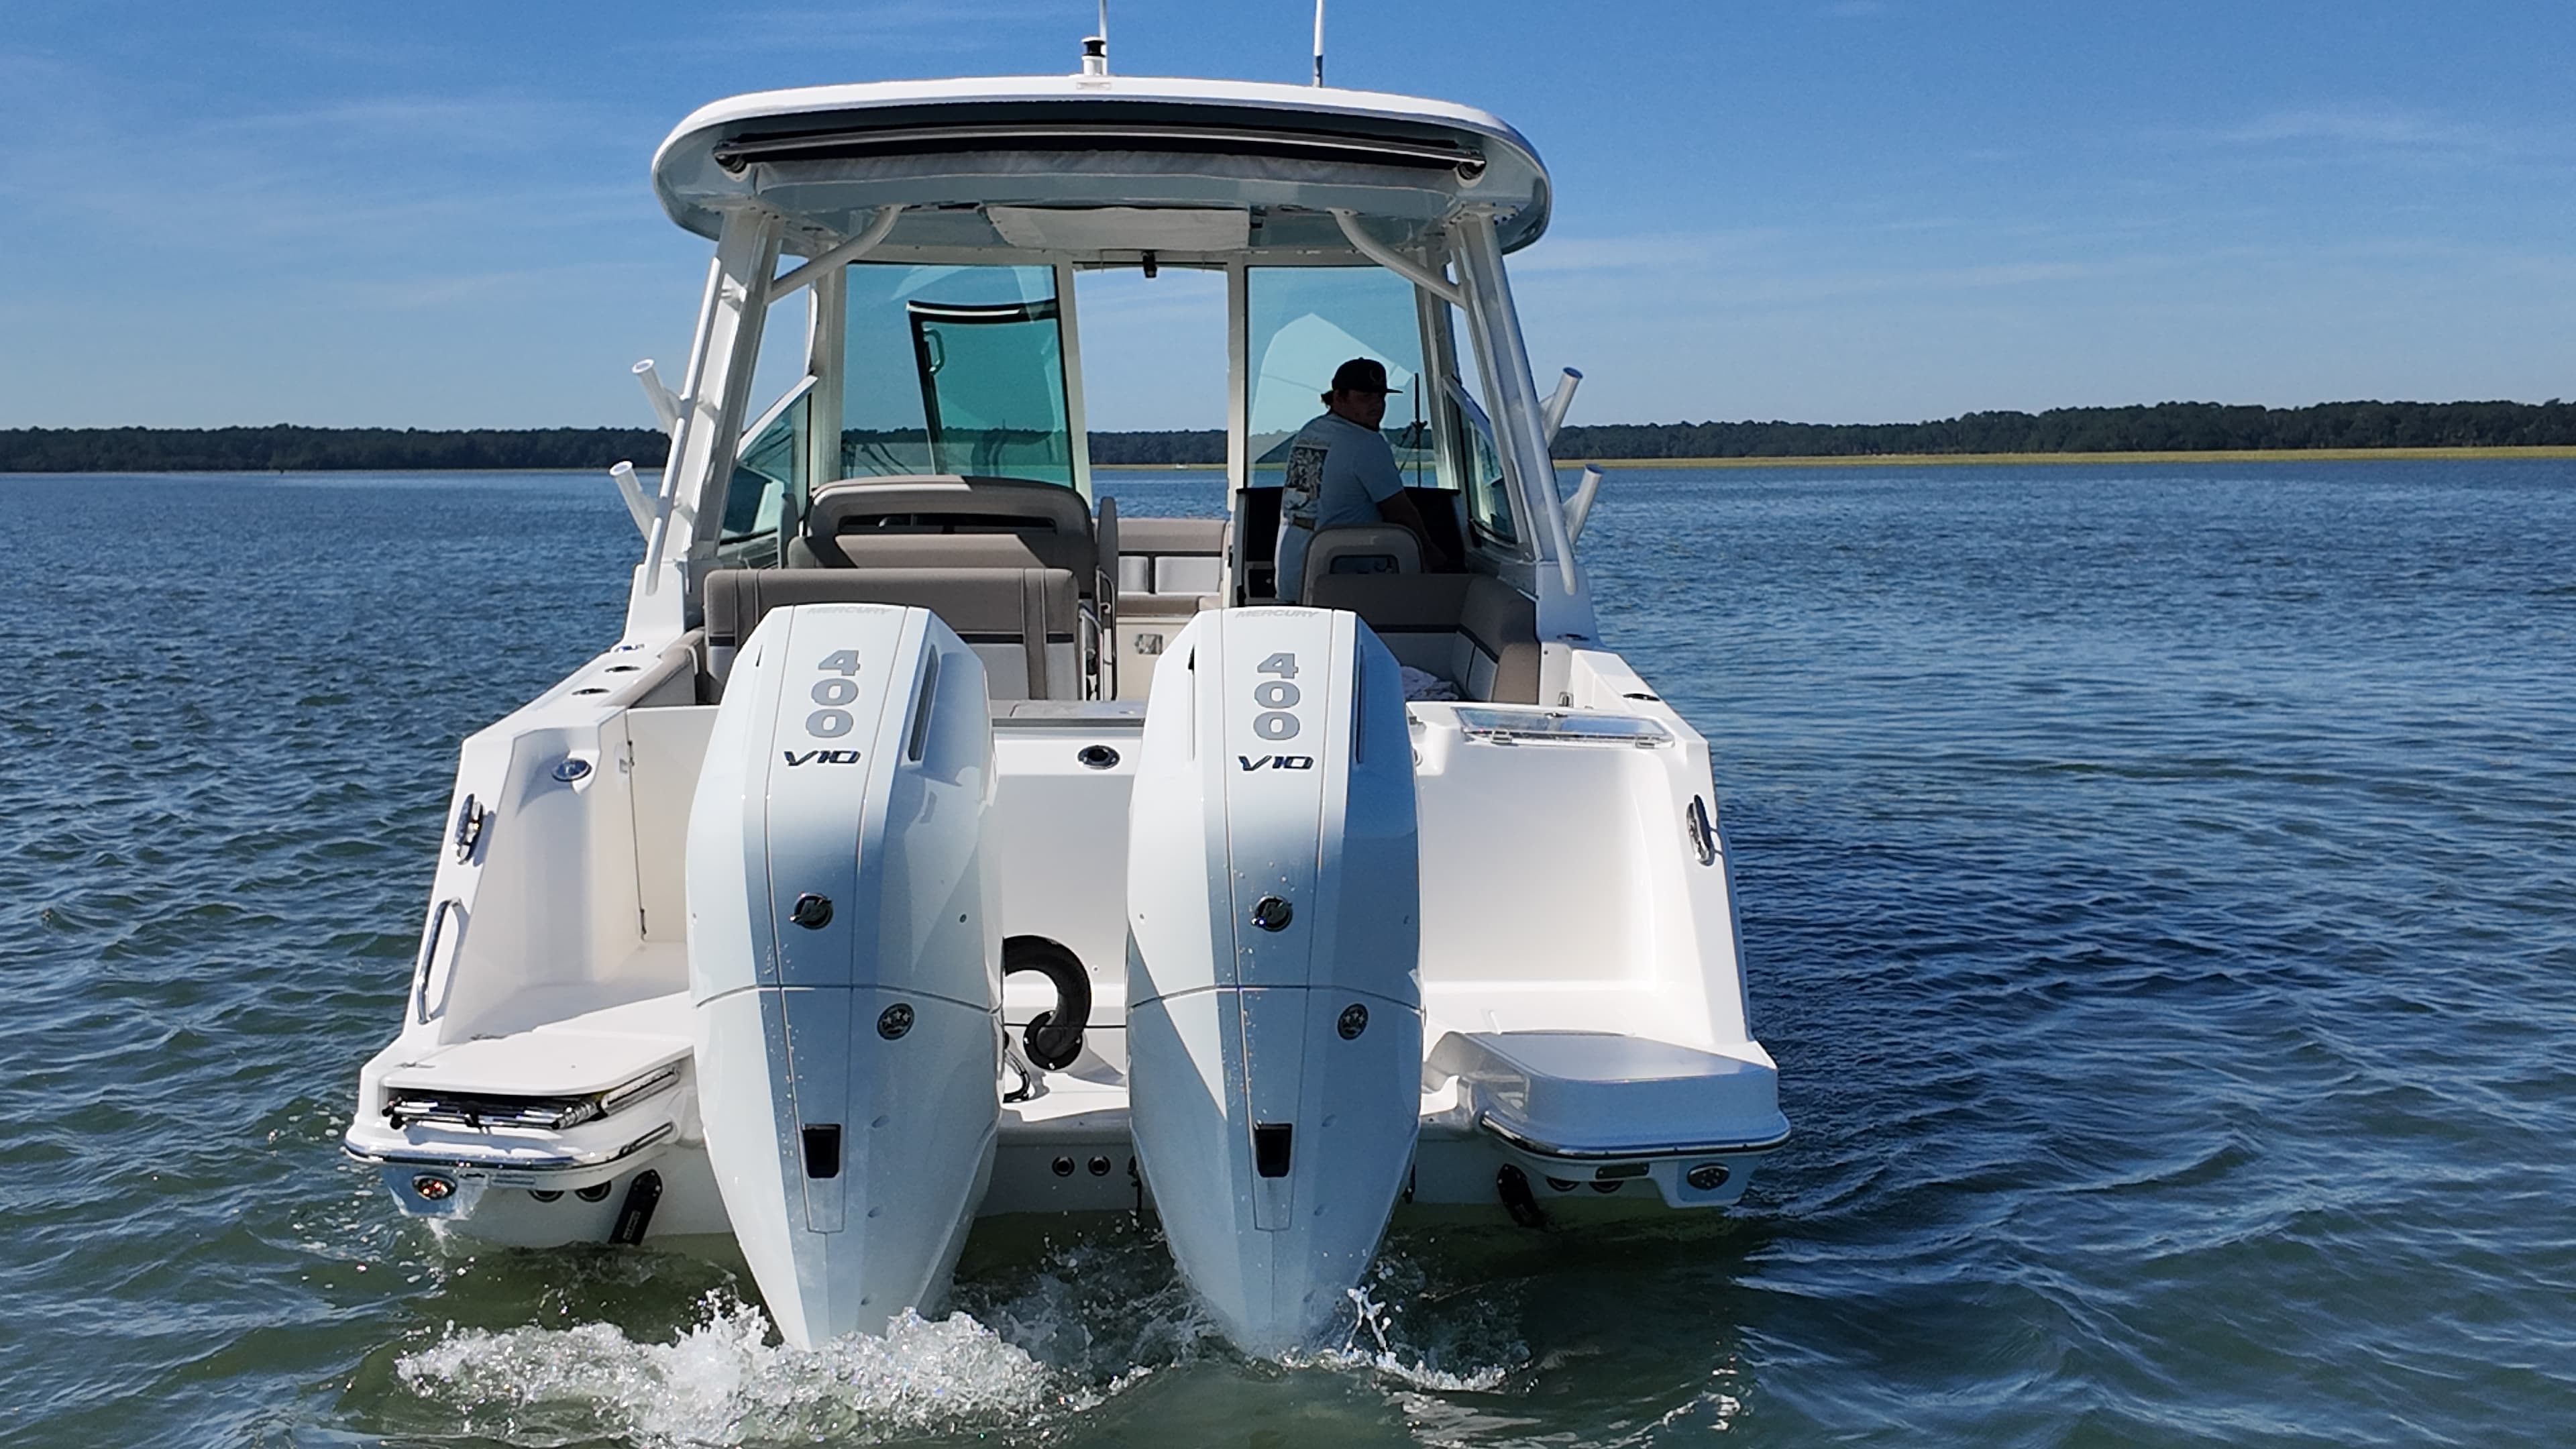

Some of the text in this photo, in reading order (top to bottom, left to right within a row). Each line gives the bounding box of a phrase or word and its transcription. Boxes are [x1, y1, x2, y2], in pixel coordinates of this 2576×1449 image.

[1235, 609, 1320, 618] MERCURY
[805, 649, 861, 738] 400
[1253, 653, 1299, 741] 400
[784, 750, 861, 766] V10
[1238, 755, 1314, 771] V10
